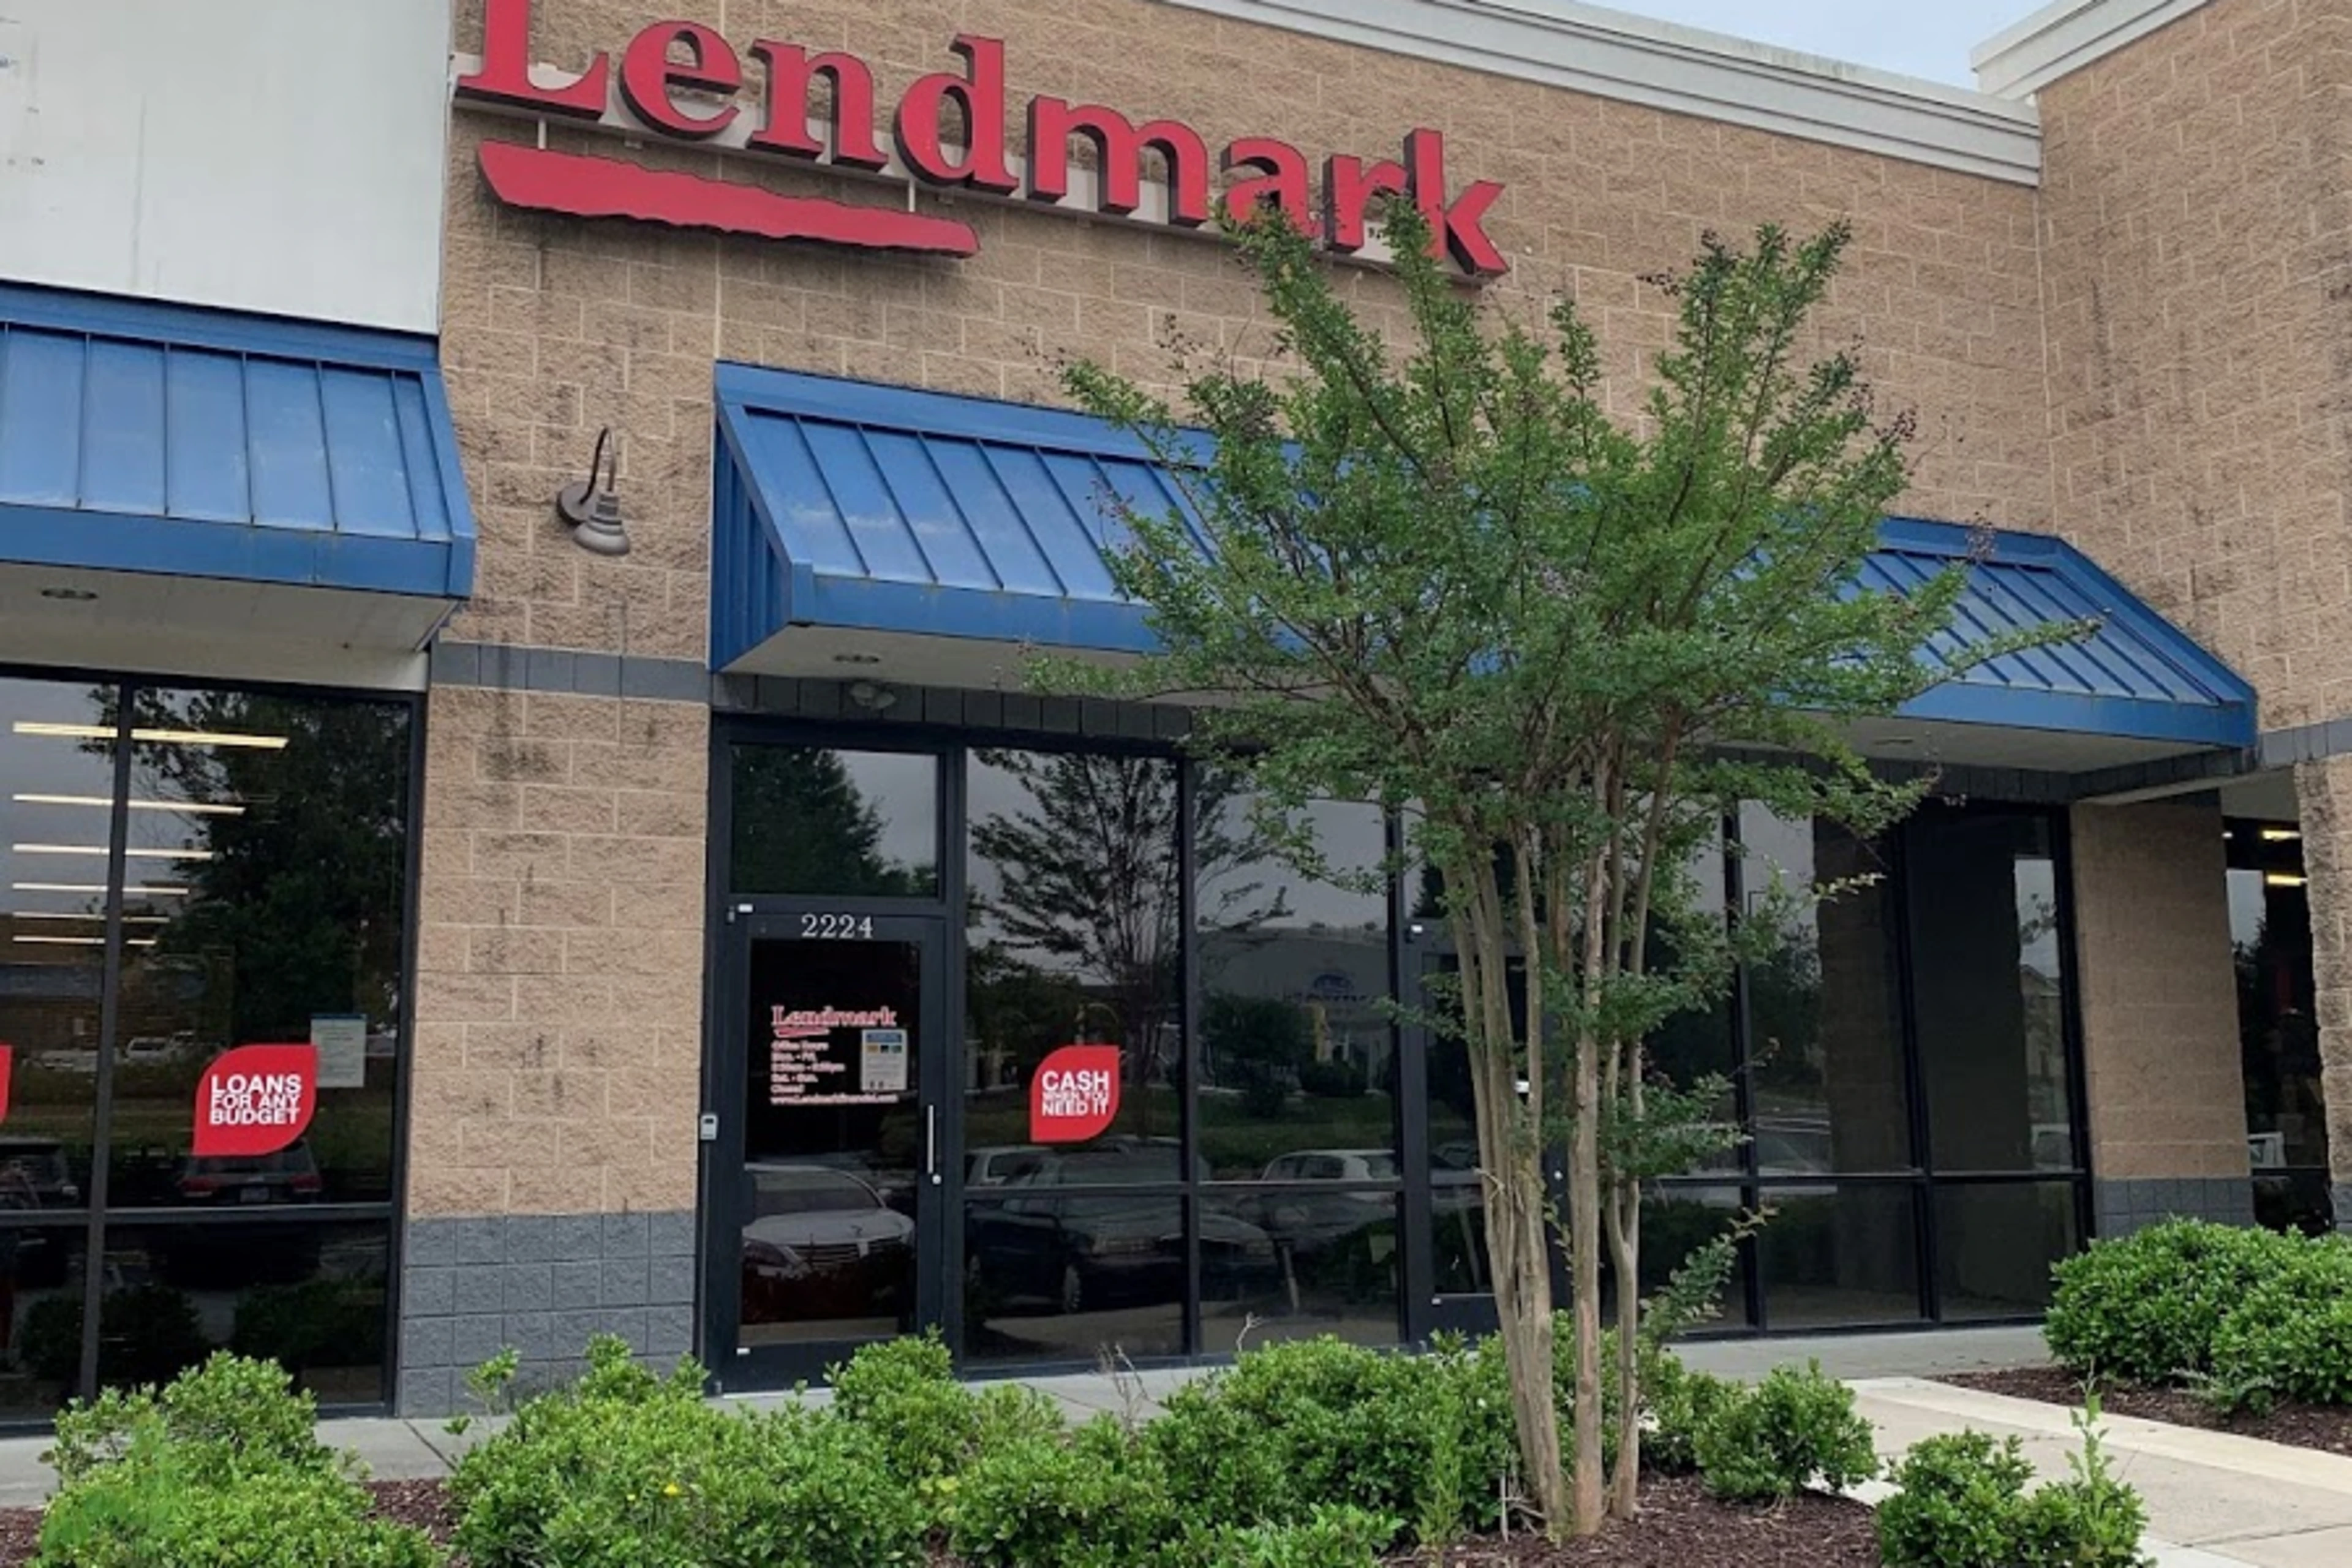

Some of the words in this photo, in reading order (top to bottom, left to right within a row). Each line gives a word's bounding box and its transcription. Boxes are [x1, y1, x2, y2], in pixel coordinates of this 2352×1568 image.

[453, 0, 1510, 276] Lendmark
[801, 913, 873, 939] 2224
[211, 1074, 302, 1094] LOANS
[1041, 1070, 1109, 1091] CASH
[211, 1094, 252, 1109] FOR
[258, 1094, 301, 1109] ANY
[1042, 1101, 1088, 1117] NEED
[1093, 1100, 1109, 1117] IT
[209, 1109, 301, 1125] BUDGET
